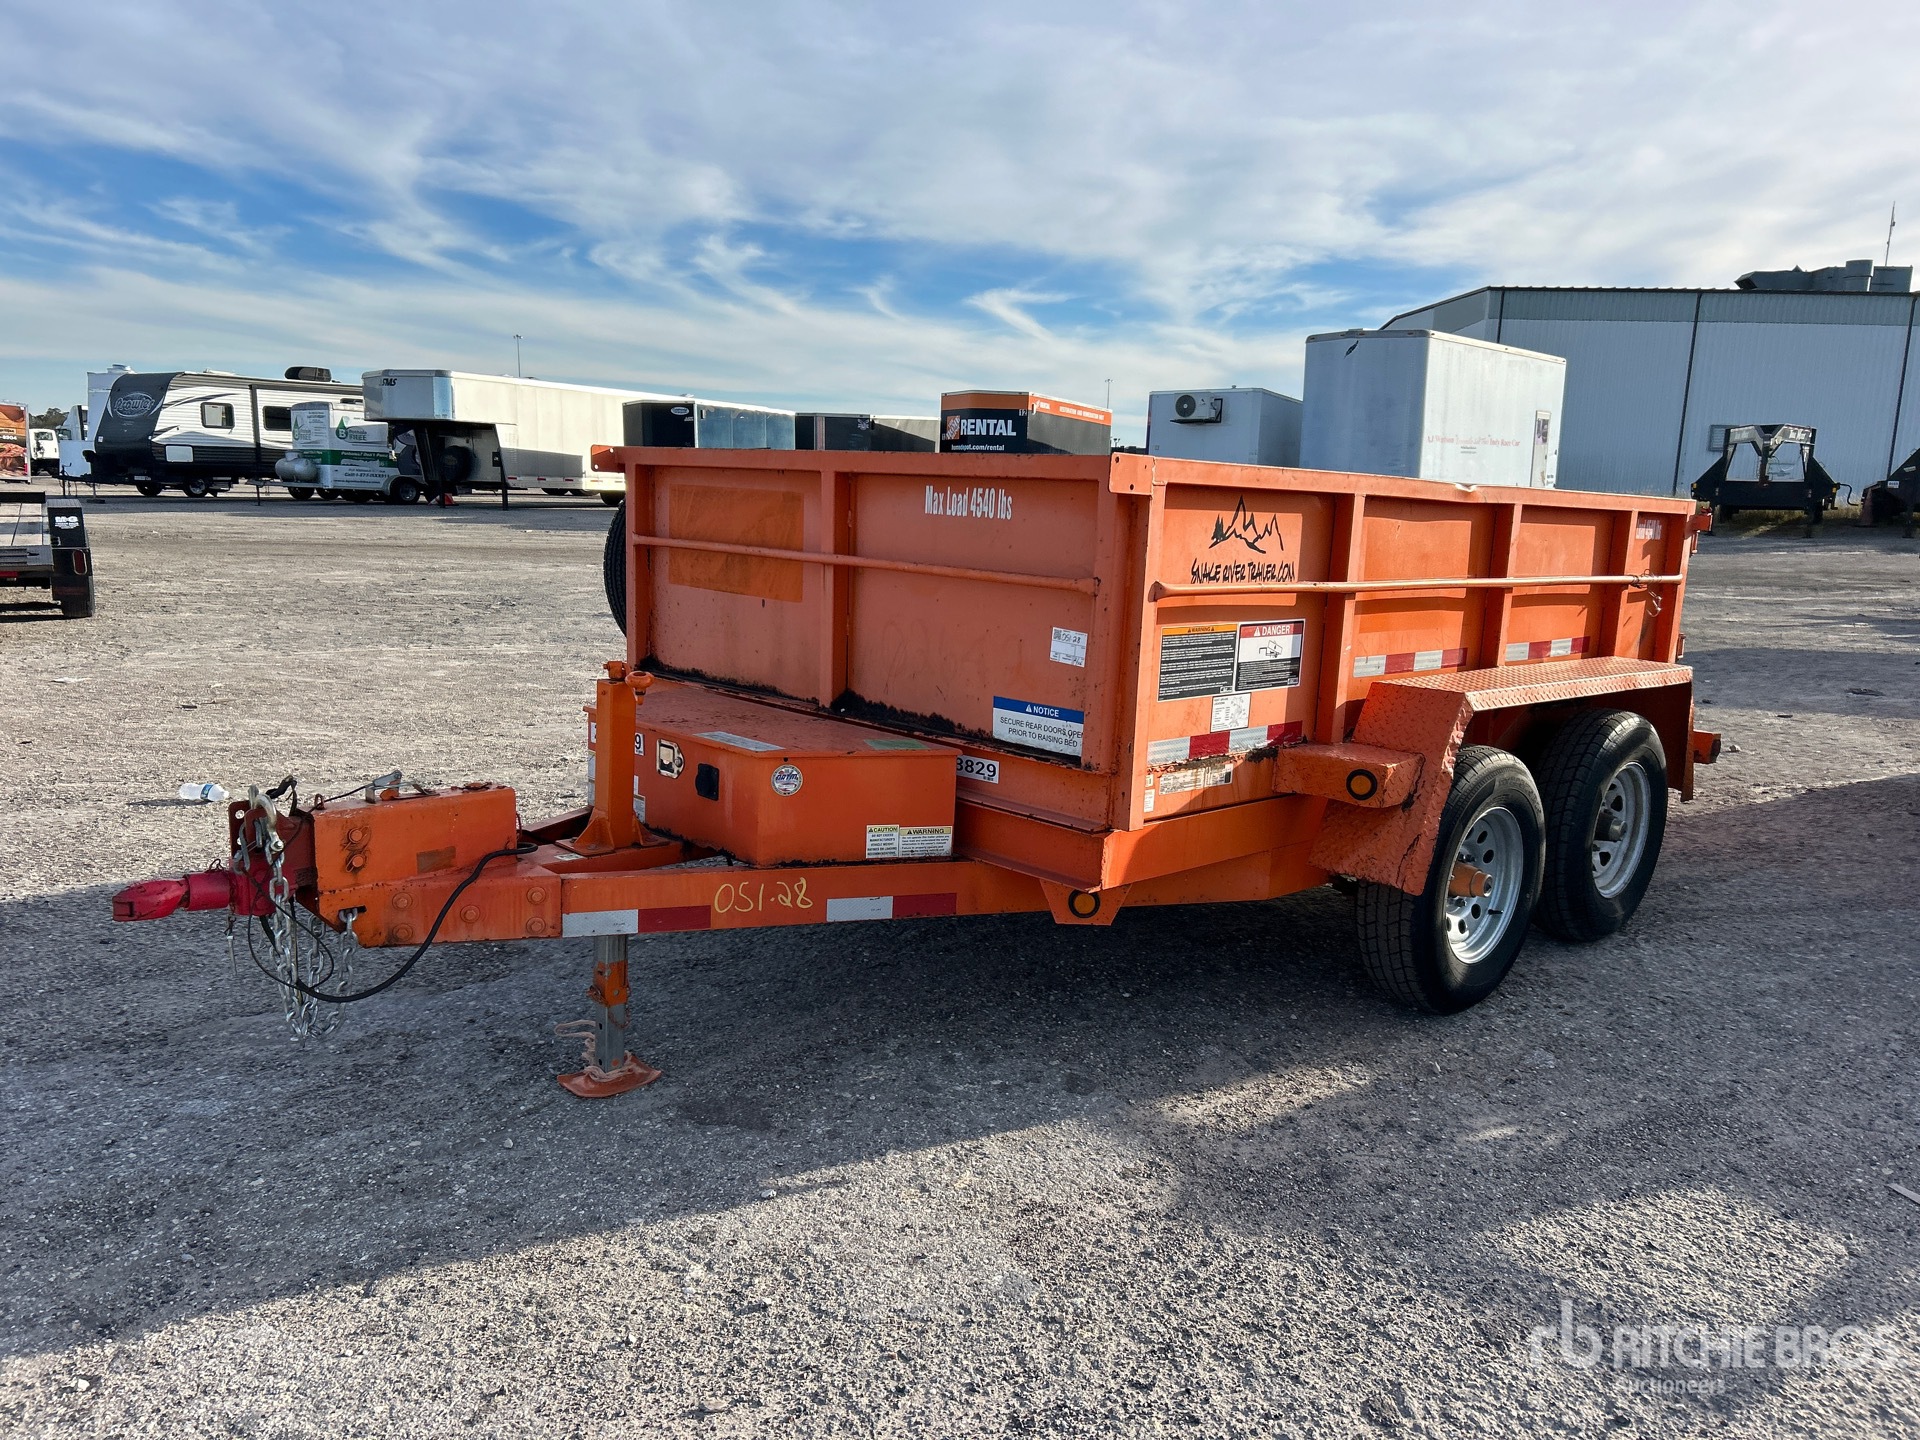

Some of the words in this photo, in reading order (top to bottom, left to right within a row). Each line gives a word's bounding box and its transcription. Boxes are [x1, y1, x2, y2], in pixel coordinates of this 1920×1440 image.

[114, 397, 155, 411] Prowler
[960, 418, 1017, 437] RENTAL
[925, 486, 943, 515] Max
[946, 486, 968, 517] Load
[970, 487, 994, 519] 4540
[998, 489, 1012, 520] lbs
[1191, 558, 1221, 584] SNAKE
[1222, 560, 1246, 582] RIVER
[1262, 625, 1290, 636] DANGER
[1033, 704, 1059, 717] NOTICE
[1000, 716, 1025, 728] SECURE
[1025, 721, 1043, 731] REAR
[1043, 724, 1066, 736] DOORS
[1008, 727, 1027, 738] PRIOR
[1028, 731, 1037, 739] TO
[1037, 733, 1063, 745] RAISING
[1064, 737, 1078, 748] BED
